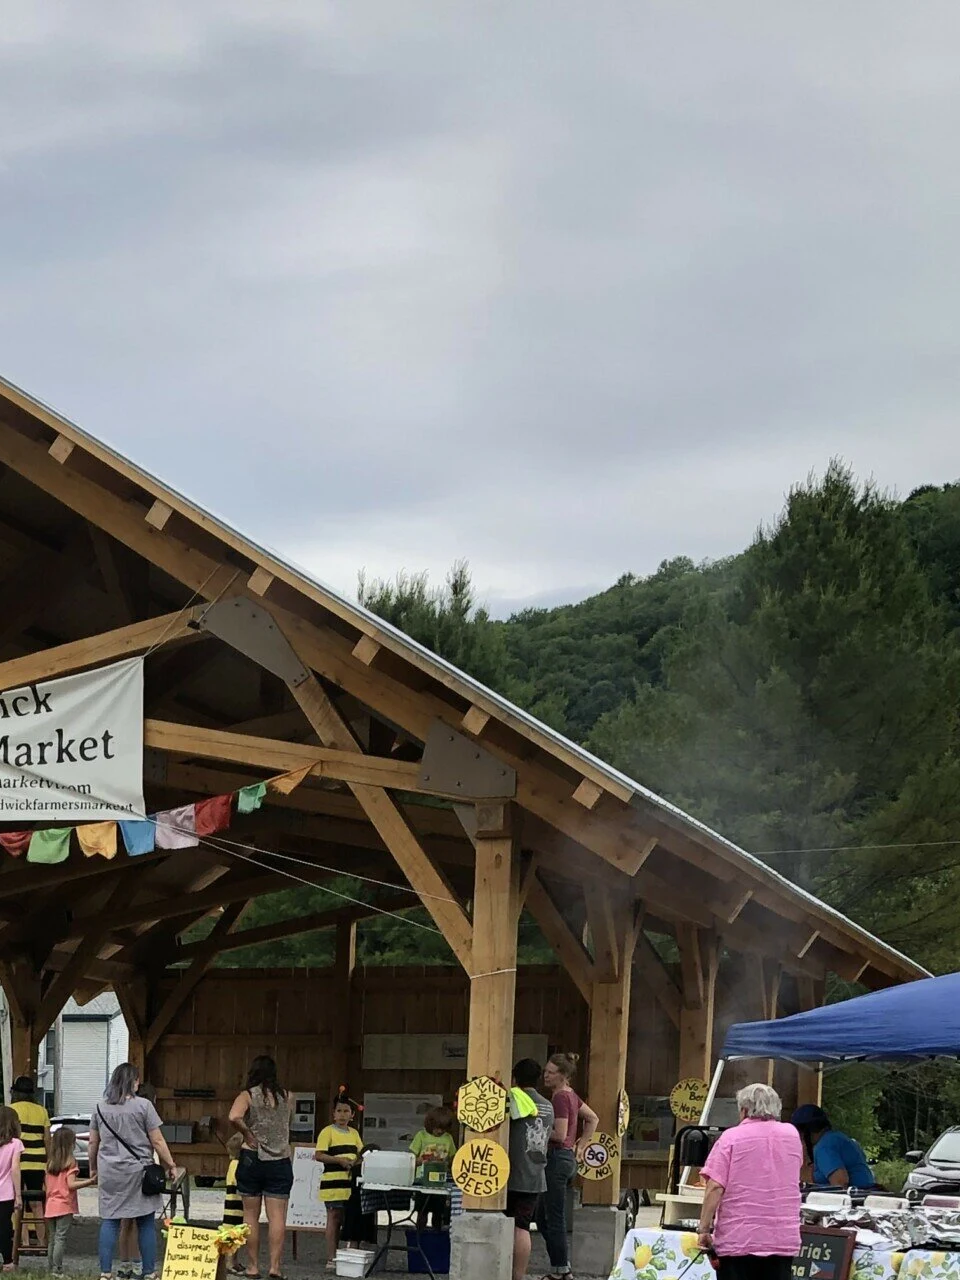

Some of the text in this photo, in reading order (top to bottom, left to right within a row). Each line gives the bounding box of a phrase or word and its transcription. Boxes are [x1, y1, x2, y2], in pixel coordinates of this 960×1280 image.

[462, 1084, 472, 1099] I
[459, 1110, 503, 1130] SURVIVE
[470, 1143, 494, 1163] WE
[598, 1133, 619, 1158] BEES
[587, 1150, 605, 1162] 5G
[460, 1159, 499, 1177] NEED
[595, 1163, 613, 1179] NO!
[455, 1172, 499, 1196] BEES!
[192, 1229, 209, 1241] bees
[164, 1265, 172, 1277] 4
[173, 1270, 189, 1280] years
[191, 1268, 198, 1277] to
